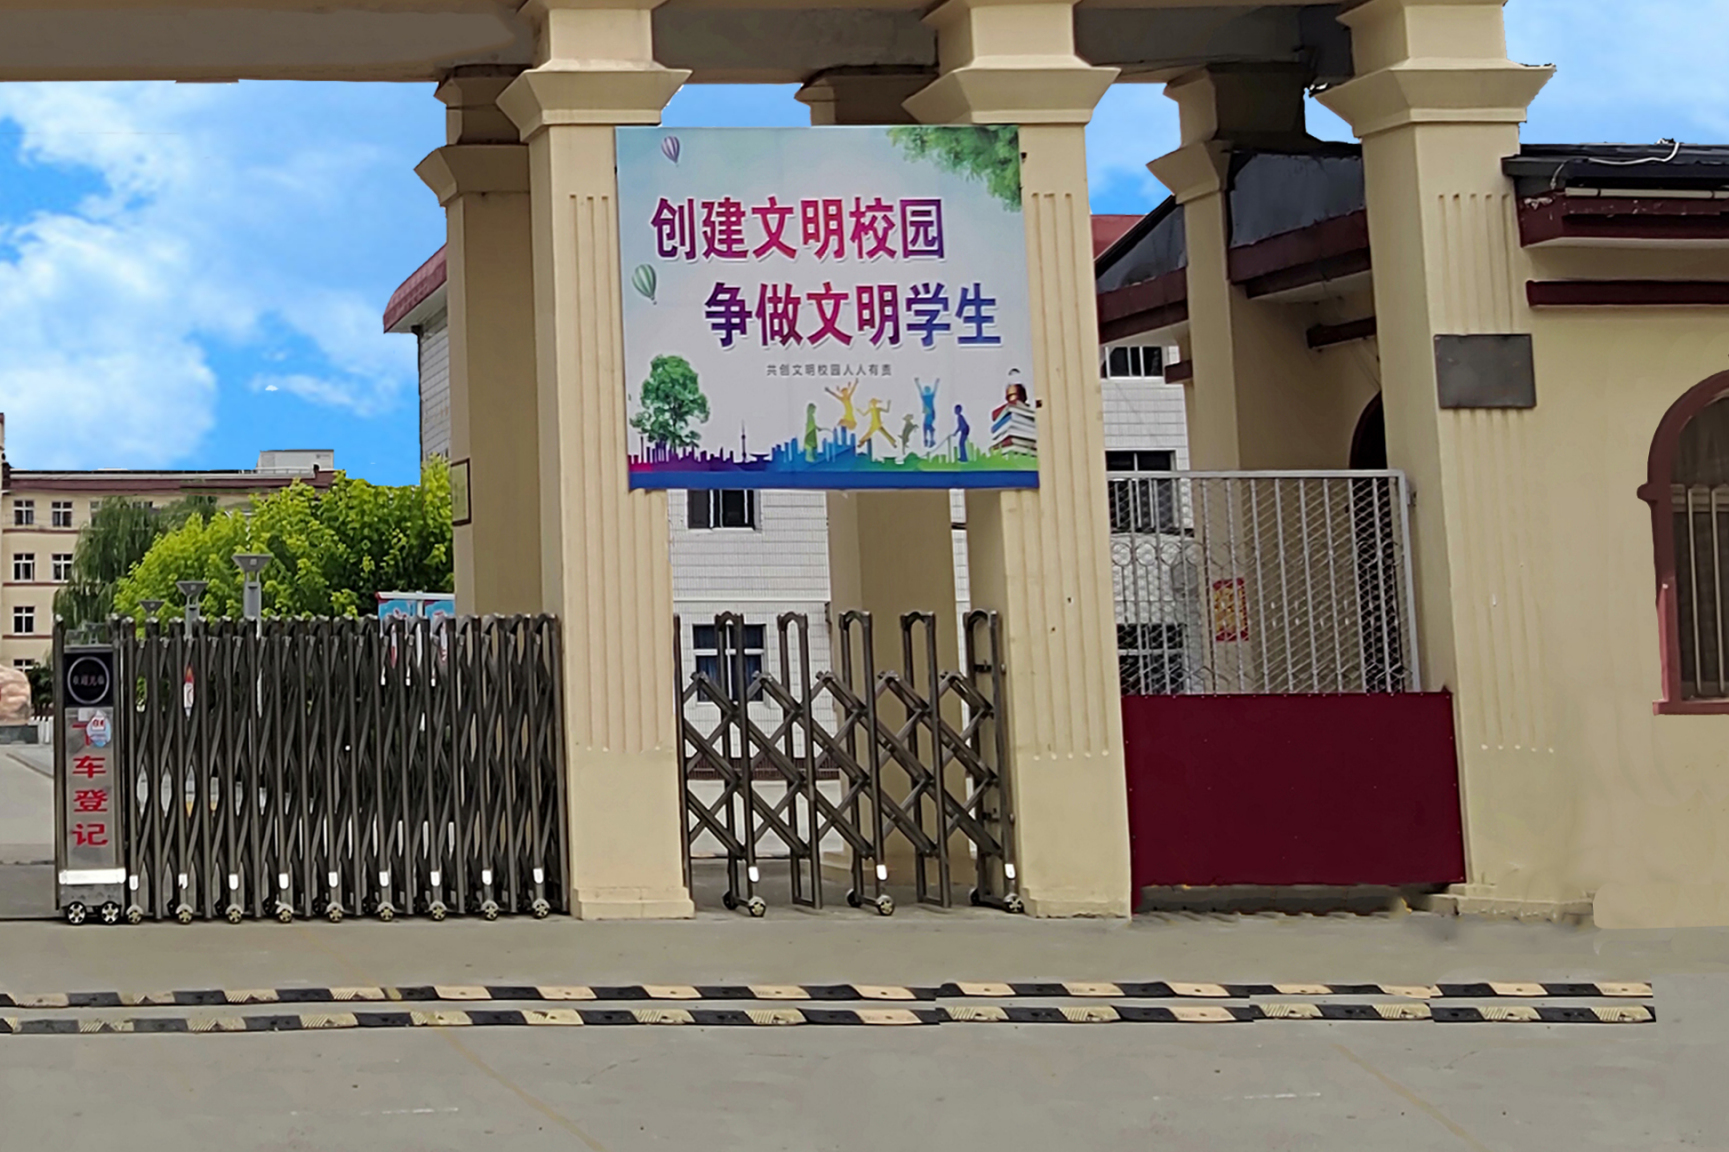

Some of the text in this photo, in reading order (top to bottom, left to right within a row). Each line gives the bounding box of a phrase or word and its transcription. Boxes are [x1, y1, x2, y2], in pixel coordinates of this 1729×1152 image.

[650, 196, 946, 260] 创建文明校园
[704, 281, 1002, 348] 争做文明学生
[766, 363, 893, 377] 共创文明校园人人有责
